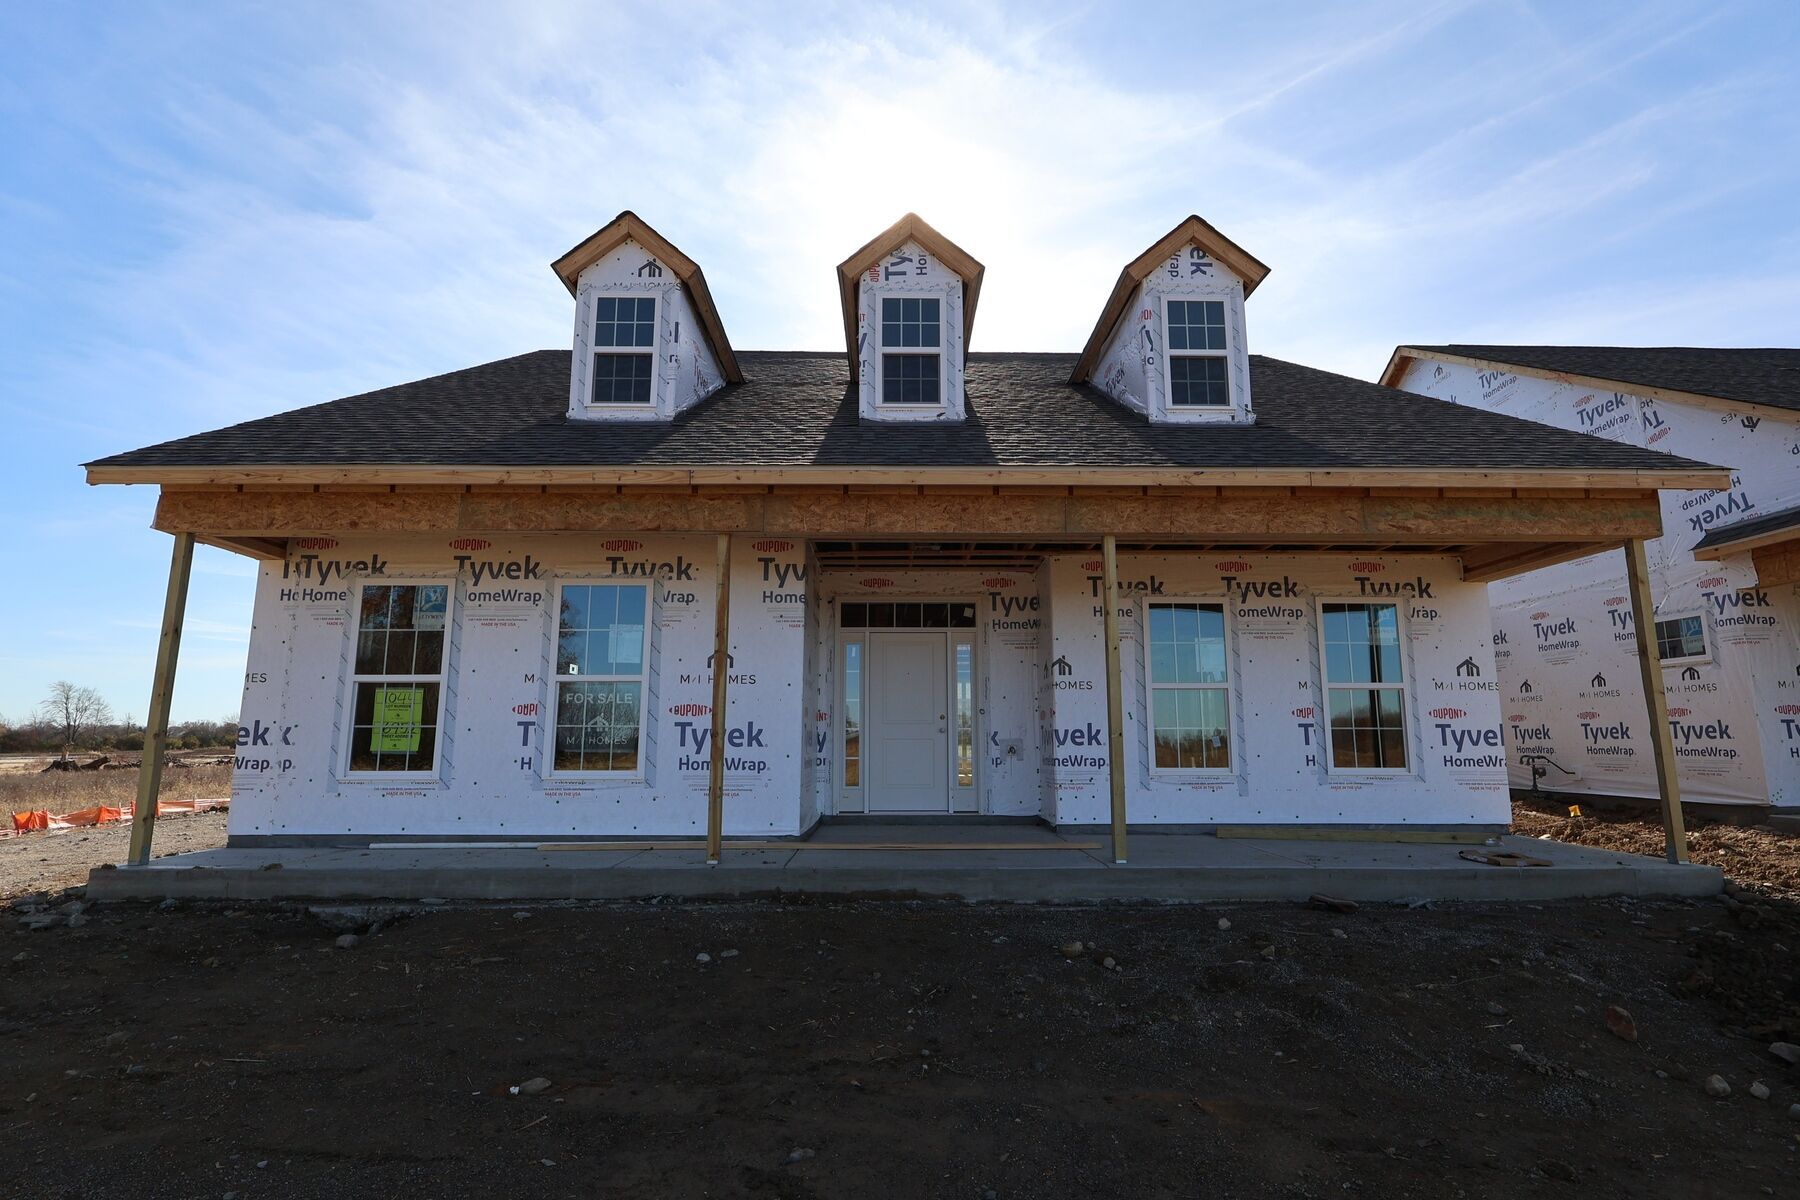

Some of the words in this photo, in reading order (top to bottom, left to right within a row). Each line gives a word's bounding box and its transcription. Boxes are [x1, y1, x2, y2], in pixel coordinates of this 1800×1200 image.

[1482, 376, 1517, 401] HomeWrap
[1576, 392, 1625, 427] Tyvek
[1688, 492, 1755, 533] Tyvek
[301, 537, 335, 550] DUPONT
[453, 538, 487, 551] DUPONT
[605, 540, 639, 552] DUPONT
[756, 540, 790, 553] DUPONT
[300, 553, 388, 587] Tyvek
[453, 555, 541, 587] Tyvek
[1219, 562, 1249, 572] DUPONT
[1352, 562, 1382, 573] DUPONT
[863, 578, 891, 588] DUPONT
[985, 578, 1013, 588] DUPONT
[1699, 577, 1725, 589] DUPONT
[1220, 576, 1299, 604] Tyvek
[465, 589, 542, 605] omeWrap
[1606, 597, 1625, 607] DUPONT
[1701, 590, 1770, 616] Tyvek
[1533, 617, 1576, 642] Tyvek
[1538, 640, 1580, 652] HomeWrap
[707, 674, 757, 685] HMES
[1459, 681, 1500, 691] HOMES
[1684, 682, 1718, 693] HOMES
[566, 693, 593, 704] FOR
[597, 693, 633, 704] SALE
[1521, 694, 1543, 703] HOMES
[1593, 689, 1621, 698] HOMES
[674, 703, 708, 717] DUPONT
[1433, 707, 1463, 719] DUPONT
[1579, 711, 1598, 720] DUPONT
[673, 721, 765, 755] Tyek
[1511, 723, 1551, 745] Tyvek
[1580, 722, 1631, 745] Tyvek
[1668, 719, 1732, 745] Tyvek
[588, 736, 628, 745] HOMES
[1516, 745, 1555, 755] HomeWrap
[1586, 746, 1634, 757] HomeWrap
[1675, 746, 1737, 760] HomeWrap
[678, 757, 767, 774] HomWrap
